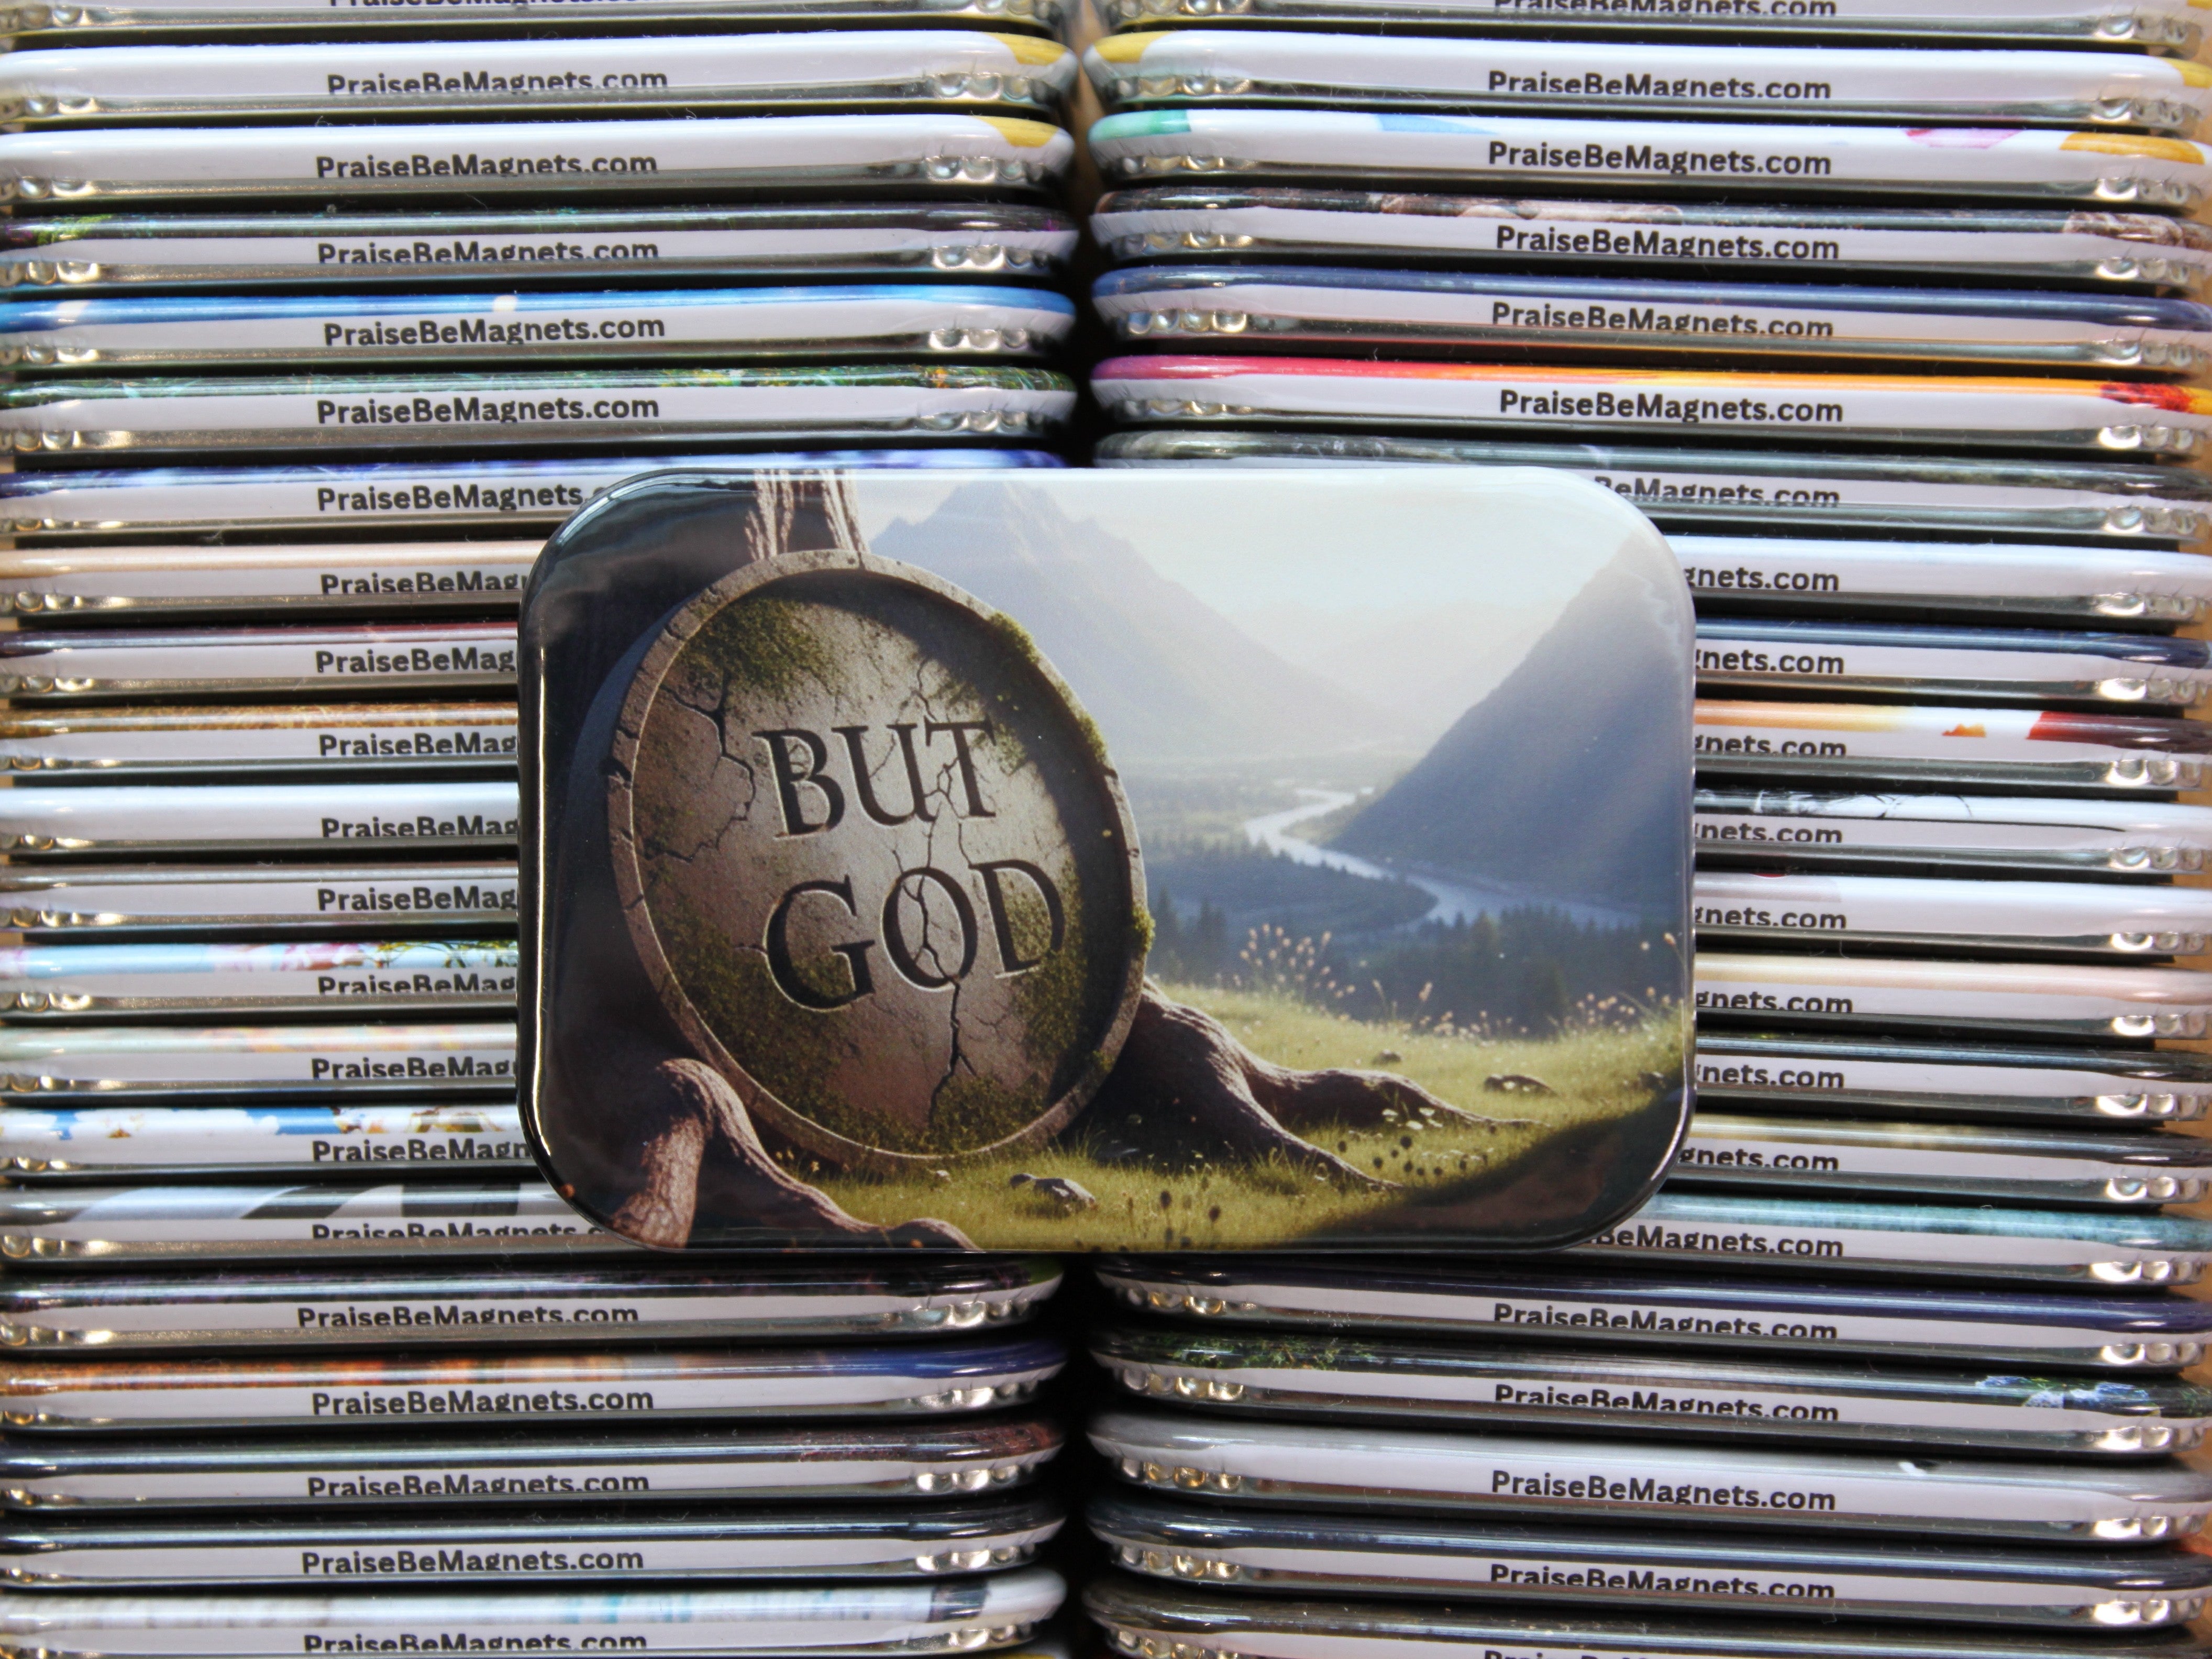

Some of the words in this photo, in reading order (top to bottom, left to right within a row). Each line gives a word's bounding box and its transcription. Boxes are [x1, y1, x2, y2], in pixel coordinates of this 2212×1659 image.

[327, 71, 668, 94] PraiseBeMagnetscom
[1489, 70, 1831, 99] PraiseBeMagnets.com
[316, 154, 657, 178] PraiseBeMagnets.com
[1489, 141, 1831, 175] PraiseBeMagnets.com
[318, 241, 658, 264] PraiseBeMagnets.com
[1497, 225, 1839, 259] PraiseBeMagnets.com
[324, 317, 665, 346] PraiseBeMagnets.com
[1492, 302, 1833, 337] PraiseBeMagnets.com
[317, 396, 659, 424] PraiseBeMagnets.com
[1500, 389, 1843, 423] PraiseBeMagnets.com
[317, 484, 605, 511] PraiseBeMagnets.
[316, 647, 516, 673] PraiseBeMag
[319, 732, 517, 756] PraiseBeMag
[751, 720, 997, 839] BUT
[1695, 823, 1843, 843] nets.com
[317, 886, 516, 911] PraiseBeMag
[764, 859, 1065, 1012] GOD
[311, 1056, 516, 1079] PraiseBeMag
[1697, 1064, 1844, 1088] nets.com
[297, 1305, 638, 1328] PraiseBeMagnets.com
[1494, 1304, 1837, 1339] PraiseBeMagnets.com
[312, 1389, 654, 1415] PraiseBeMagnets.com
[307, 1474, 649, 1498] PraiseBeMagnets.com
[1491, 1470, 1835, 1511] PraiseBeMagnets.com
[302, 1550, 644, 1575] PraiseBeMagnets.com
[1490, 1564, 1834, 1598] PraiseBeMagnets.com
[304, 1633, 647, 1653] PraiseBeMagnetscom
